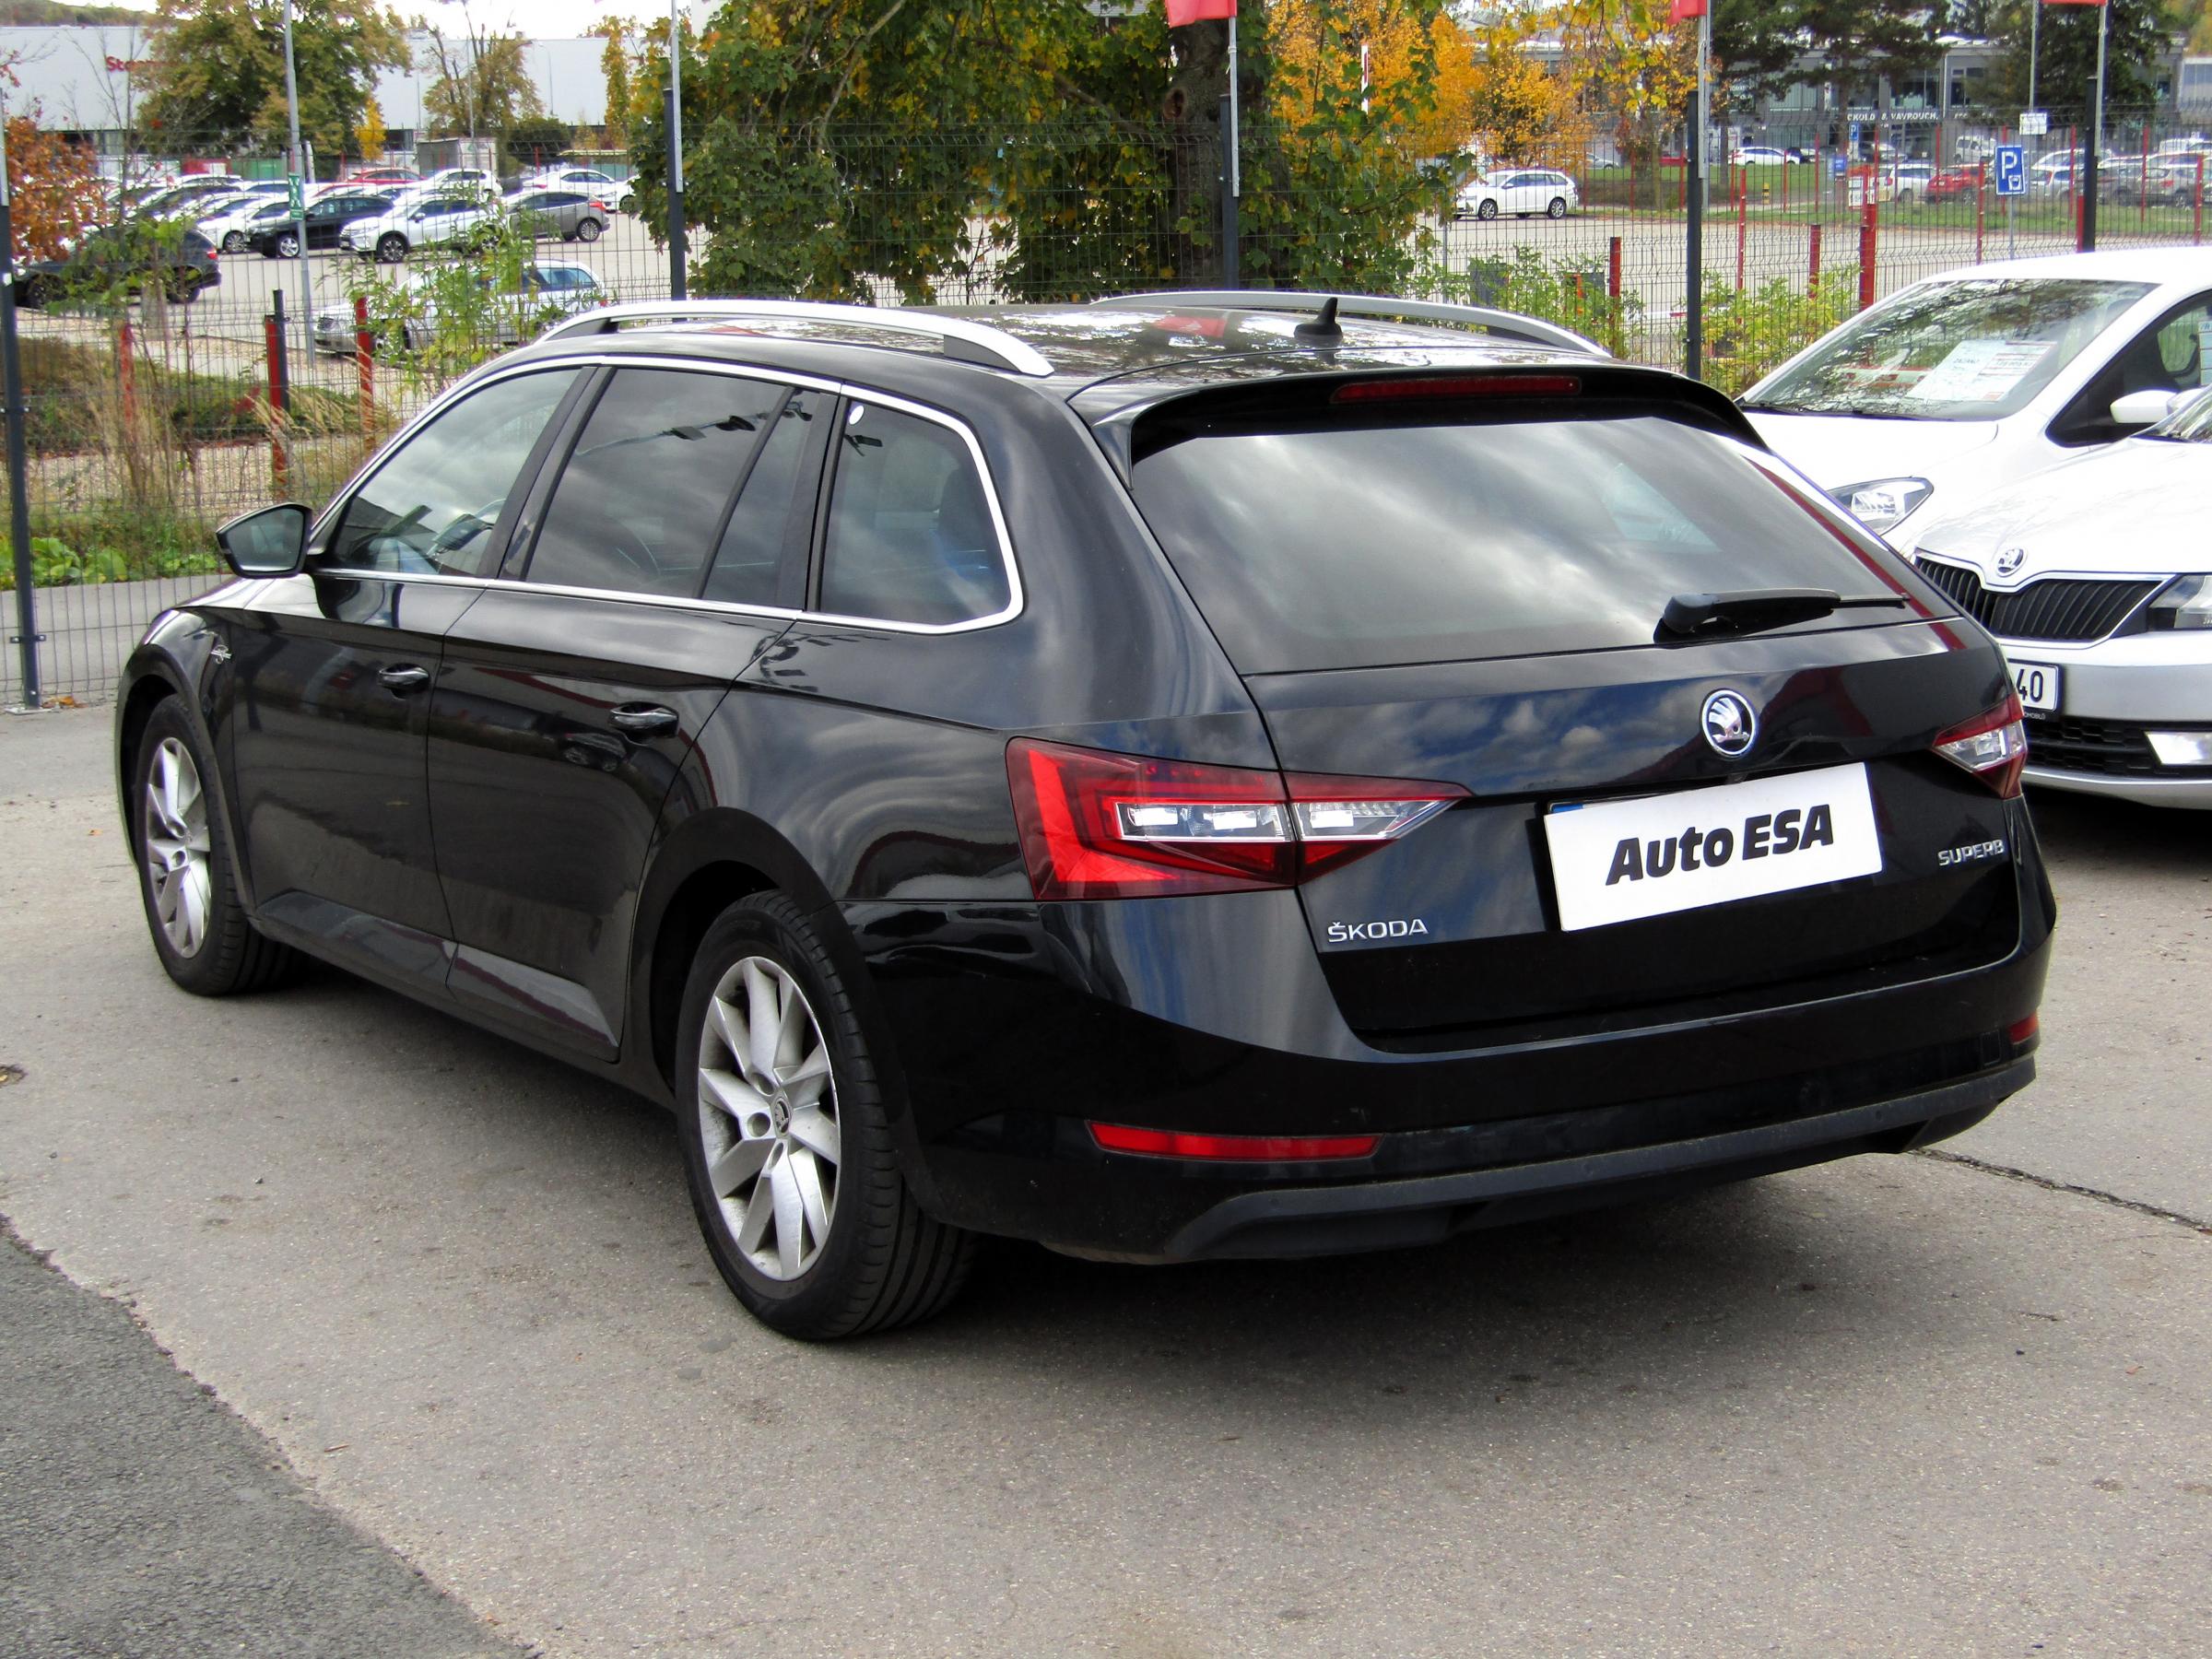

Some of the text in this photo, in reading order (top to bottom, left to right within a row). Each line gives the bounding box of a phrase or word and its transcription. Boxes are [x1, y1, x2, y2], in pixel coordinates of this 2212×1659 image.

[2001, 151, 2018, 180] P
[1605, 803, 1834, 887] Auto ESA
[1937, 839, 2005, 866] SUPERB
[1327, 918, 1430, 943] ŠKODA
